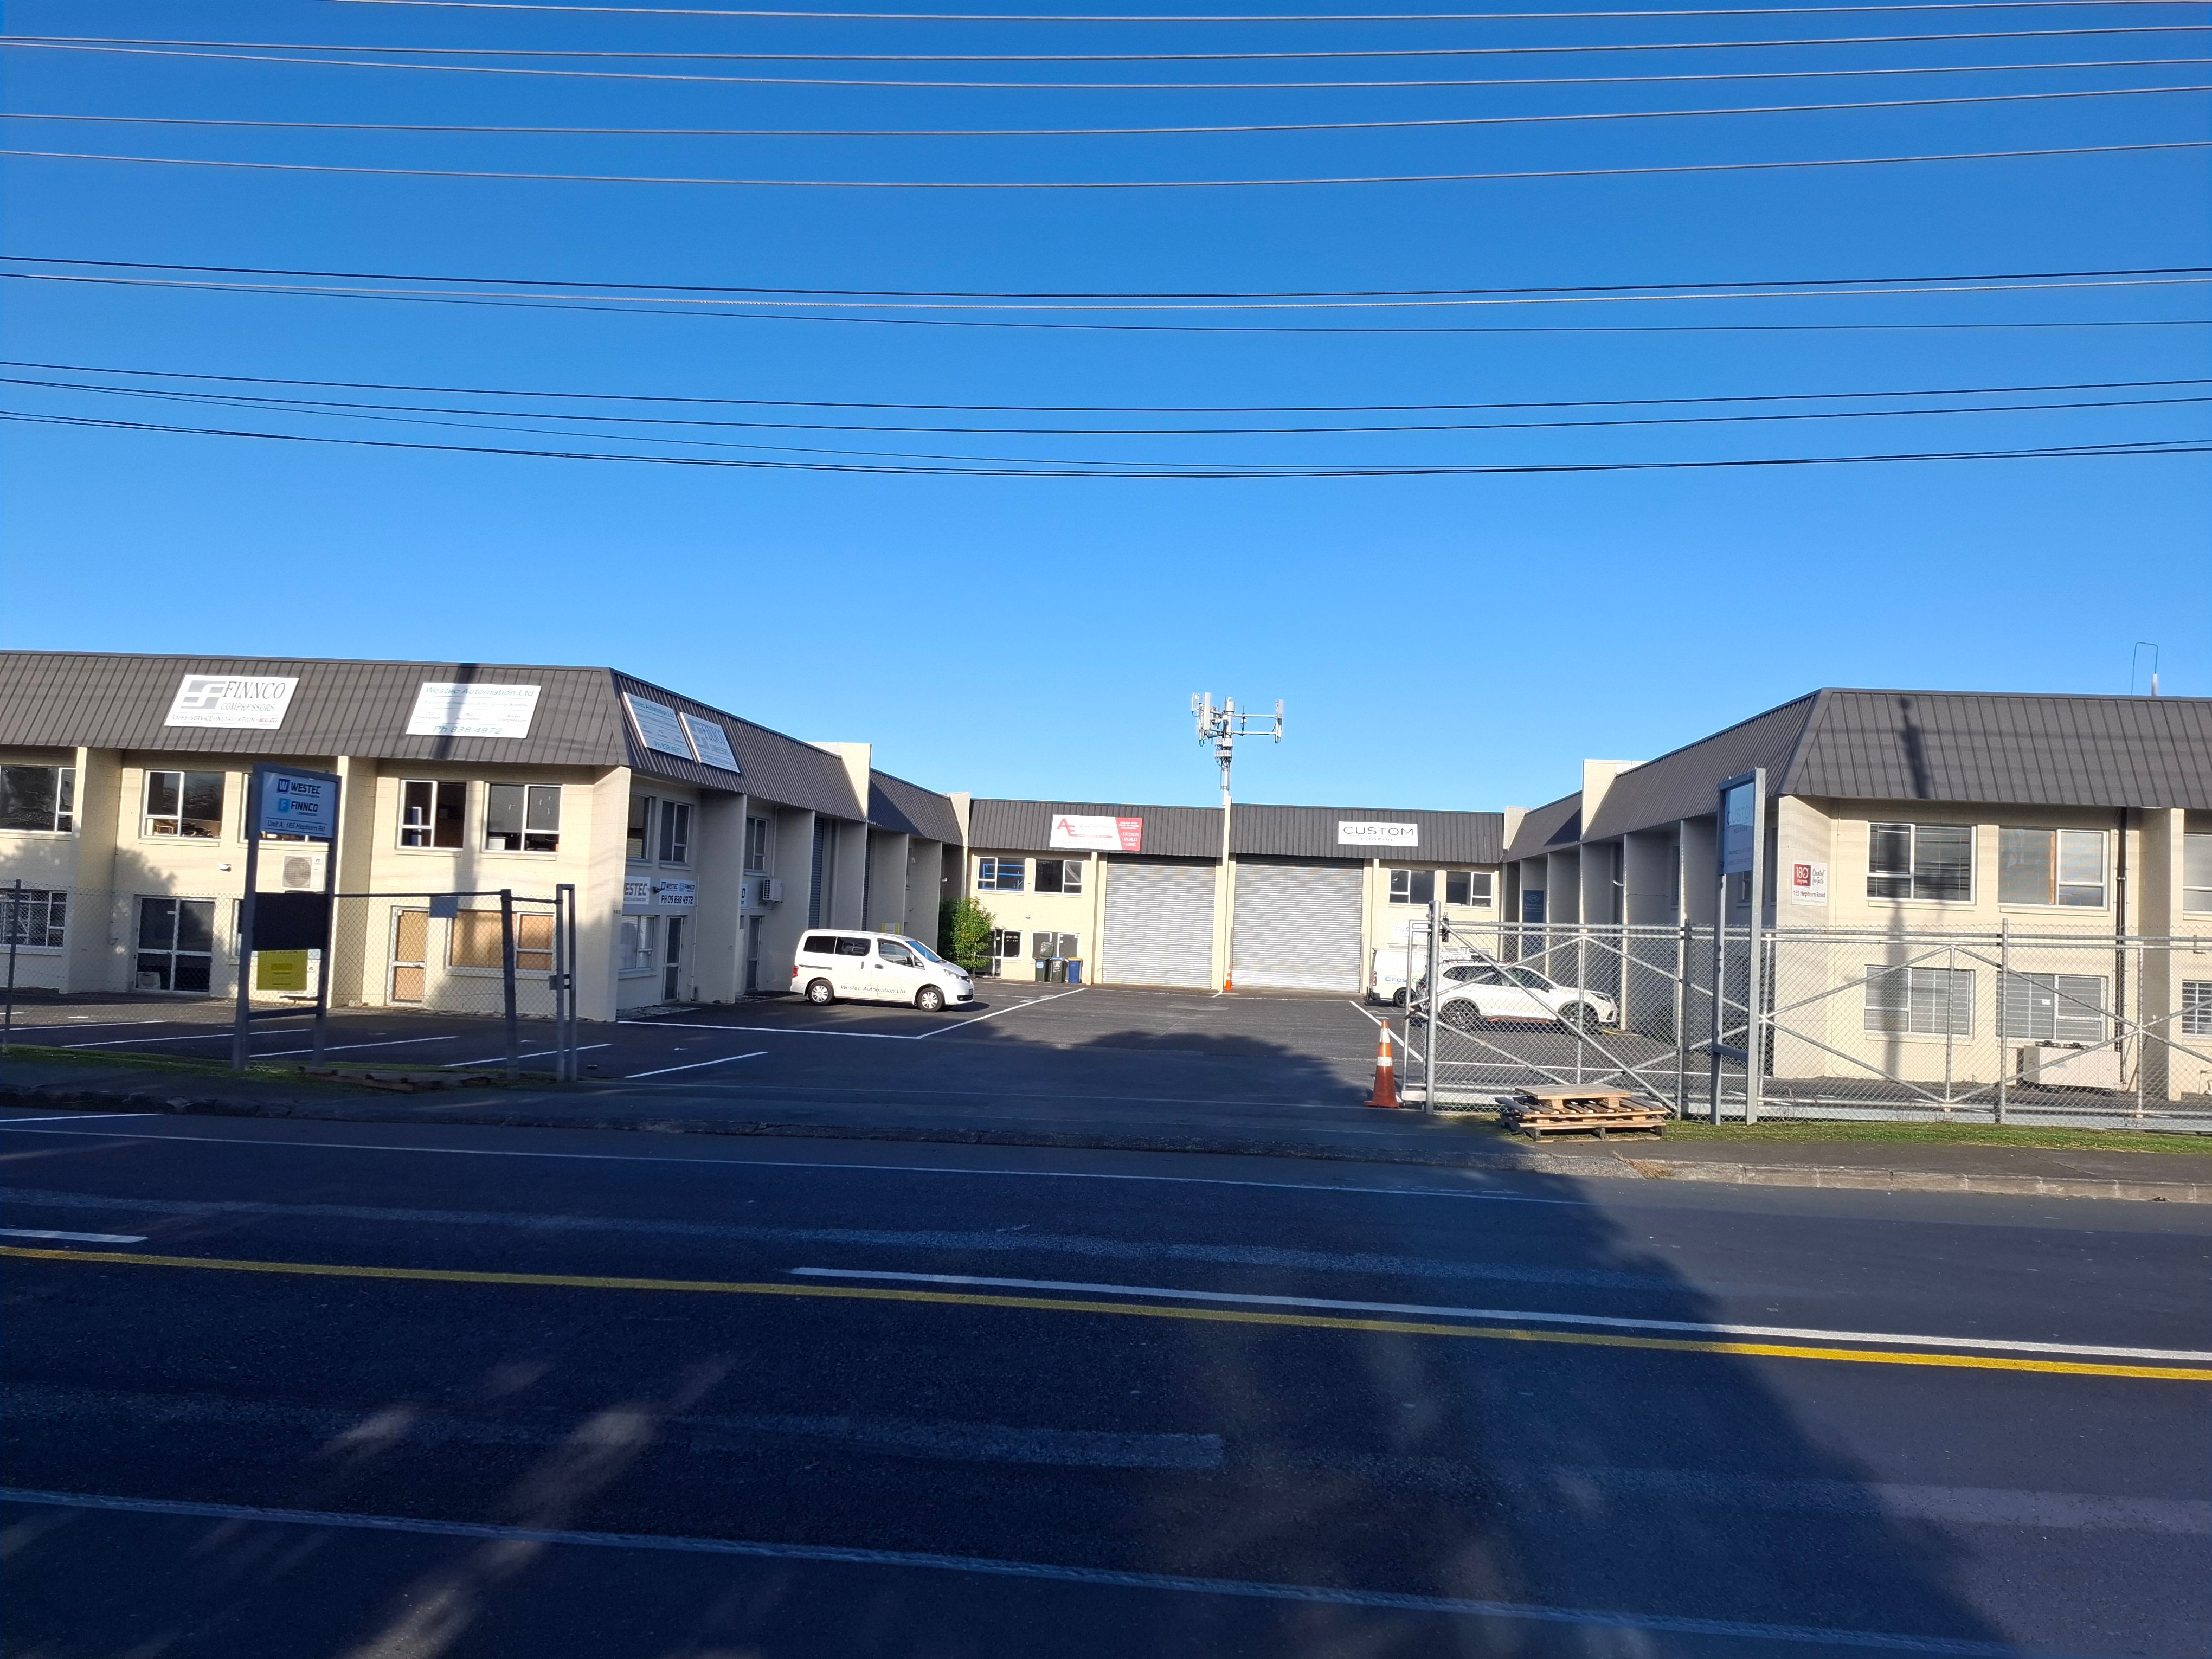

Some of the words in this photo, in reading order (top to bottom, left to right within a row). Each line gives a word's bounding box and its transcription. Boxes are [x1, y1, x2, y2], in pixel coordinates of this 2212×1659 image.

[223, 681, 286, 699] FINNCO
[461, 686, 516, 696] Automation
[221, 703, 275, 712] COMPRESSORS
[291, 782, 321, 794] WESTEC
[291, 801, 319, 812] FINNCO
[1343, 826, 1413, 836] CUSTOM
[1796, 867, 1809, 879] 180
[661, 895, 667, 904] PH
[667, 895, 674, 904] 09
[674, 895, 682, 904] 838
[683, 896, 693, 904] 4972
